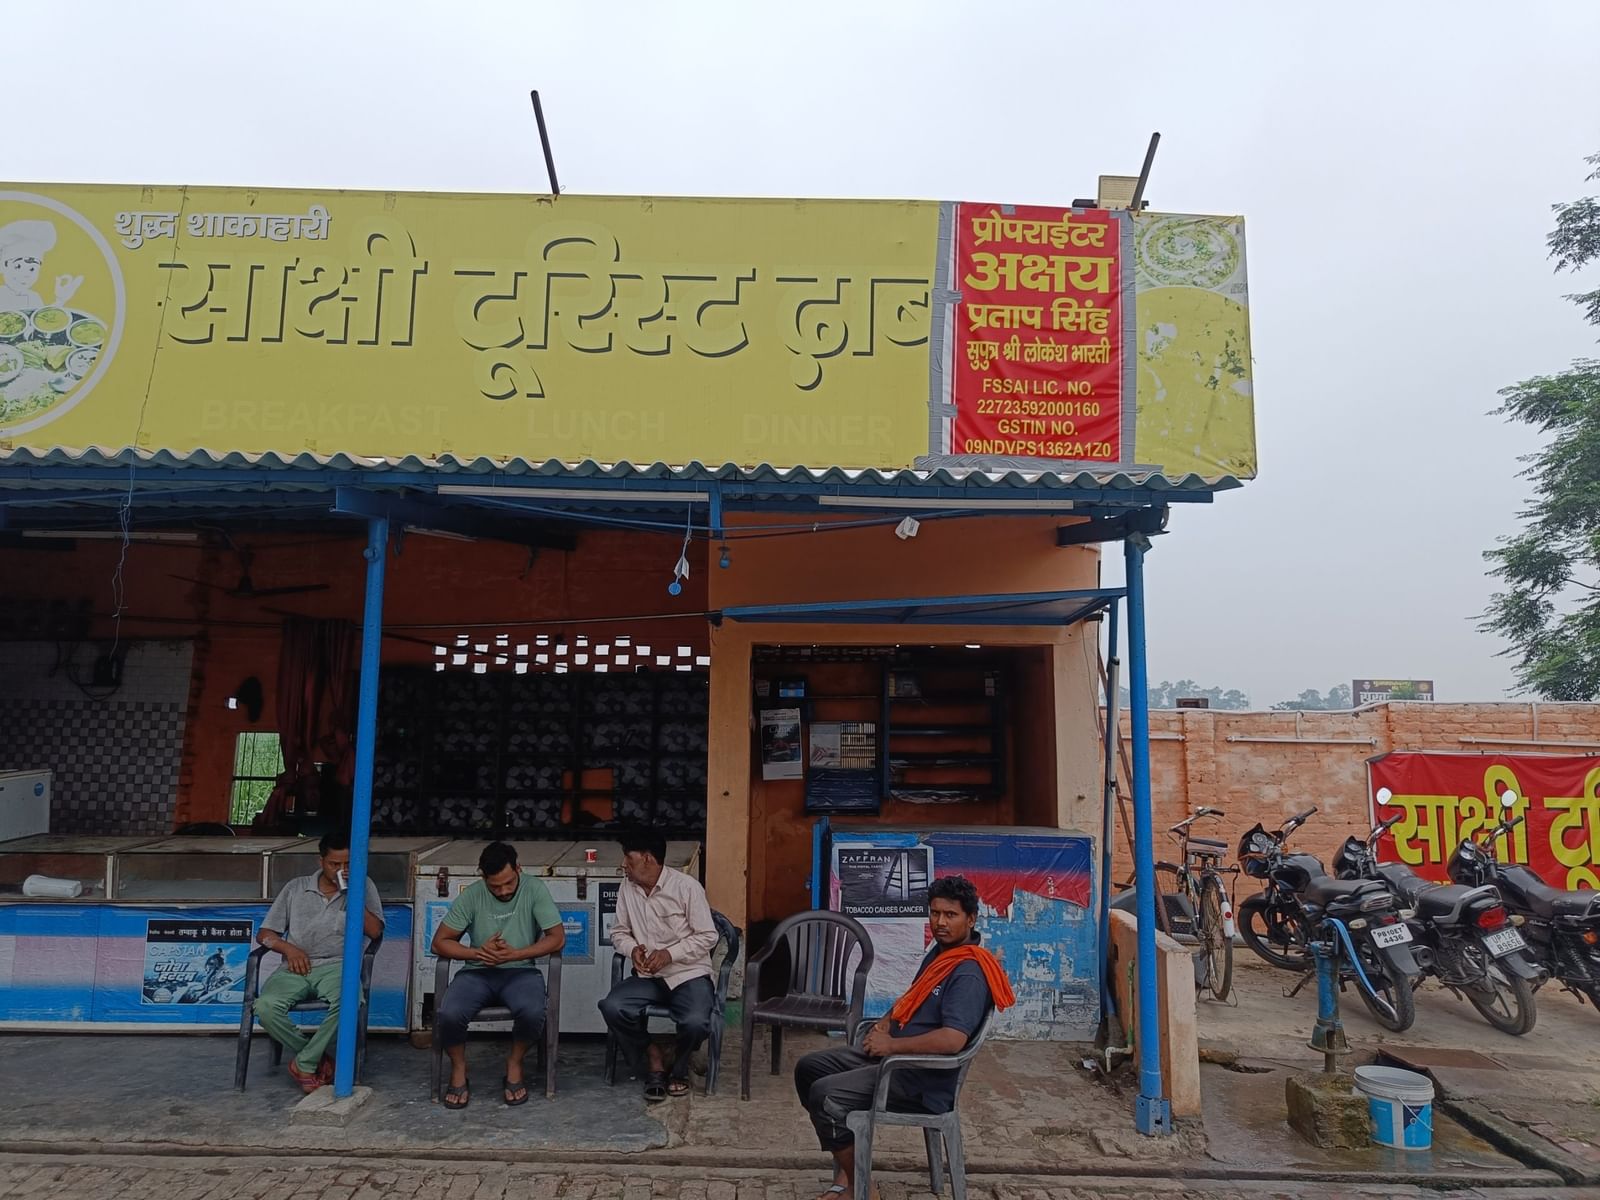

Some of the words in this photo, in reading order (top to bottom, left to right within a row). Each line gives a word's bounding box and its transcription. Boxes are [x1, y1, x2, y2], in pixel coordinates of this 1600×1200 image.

[116, 211, 180, 249] शुद्ध
[186, 204, 332, 242] शाकाहारी
[971, 209, 1108, 249] प्रोपराईटर
[152, 218, 429, 347] साक्षी
[964, 252, 1115, 294] अक्षय
[966, 303, 1044, 333] प्रताप
[1050, 297, 1111, 335] सिंह
[966, 340, 999, 371] सुपुत्र
[1002, 334, 1021, 362] श्री
[1024, 336, 1069, 363] लोकेश
[1071, 336, 1111, 364] भारती
[982, 378, 1029, 394] FSSAI
[1033, 380, 1063, 395] LIC.
[1067, 381, 1095, 396] NO.
[201, 399, 448, 436] BREAKFAST
[528, 408, 665, 441] LUNCH
[743, 413, 894, 448] DINNER
[976, 399, 1100, 417] 22723592000160
[997, 419, 1046, 436] GSTIN
[1051, 420, 1079, 437] NO.
[841, 855, 891, 864] ZAFFRAN
[845, 906, 874, 914] TOBACCO
[874, 905, 898, 914] CAUSES
[898, 905, 924, 913] CANCER
